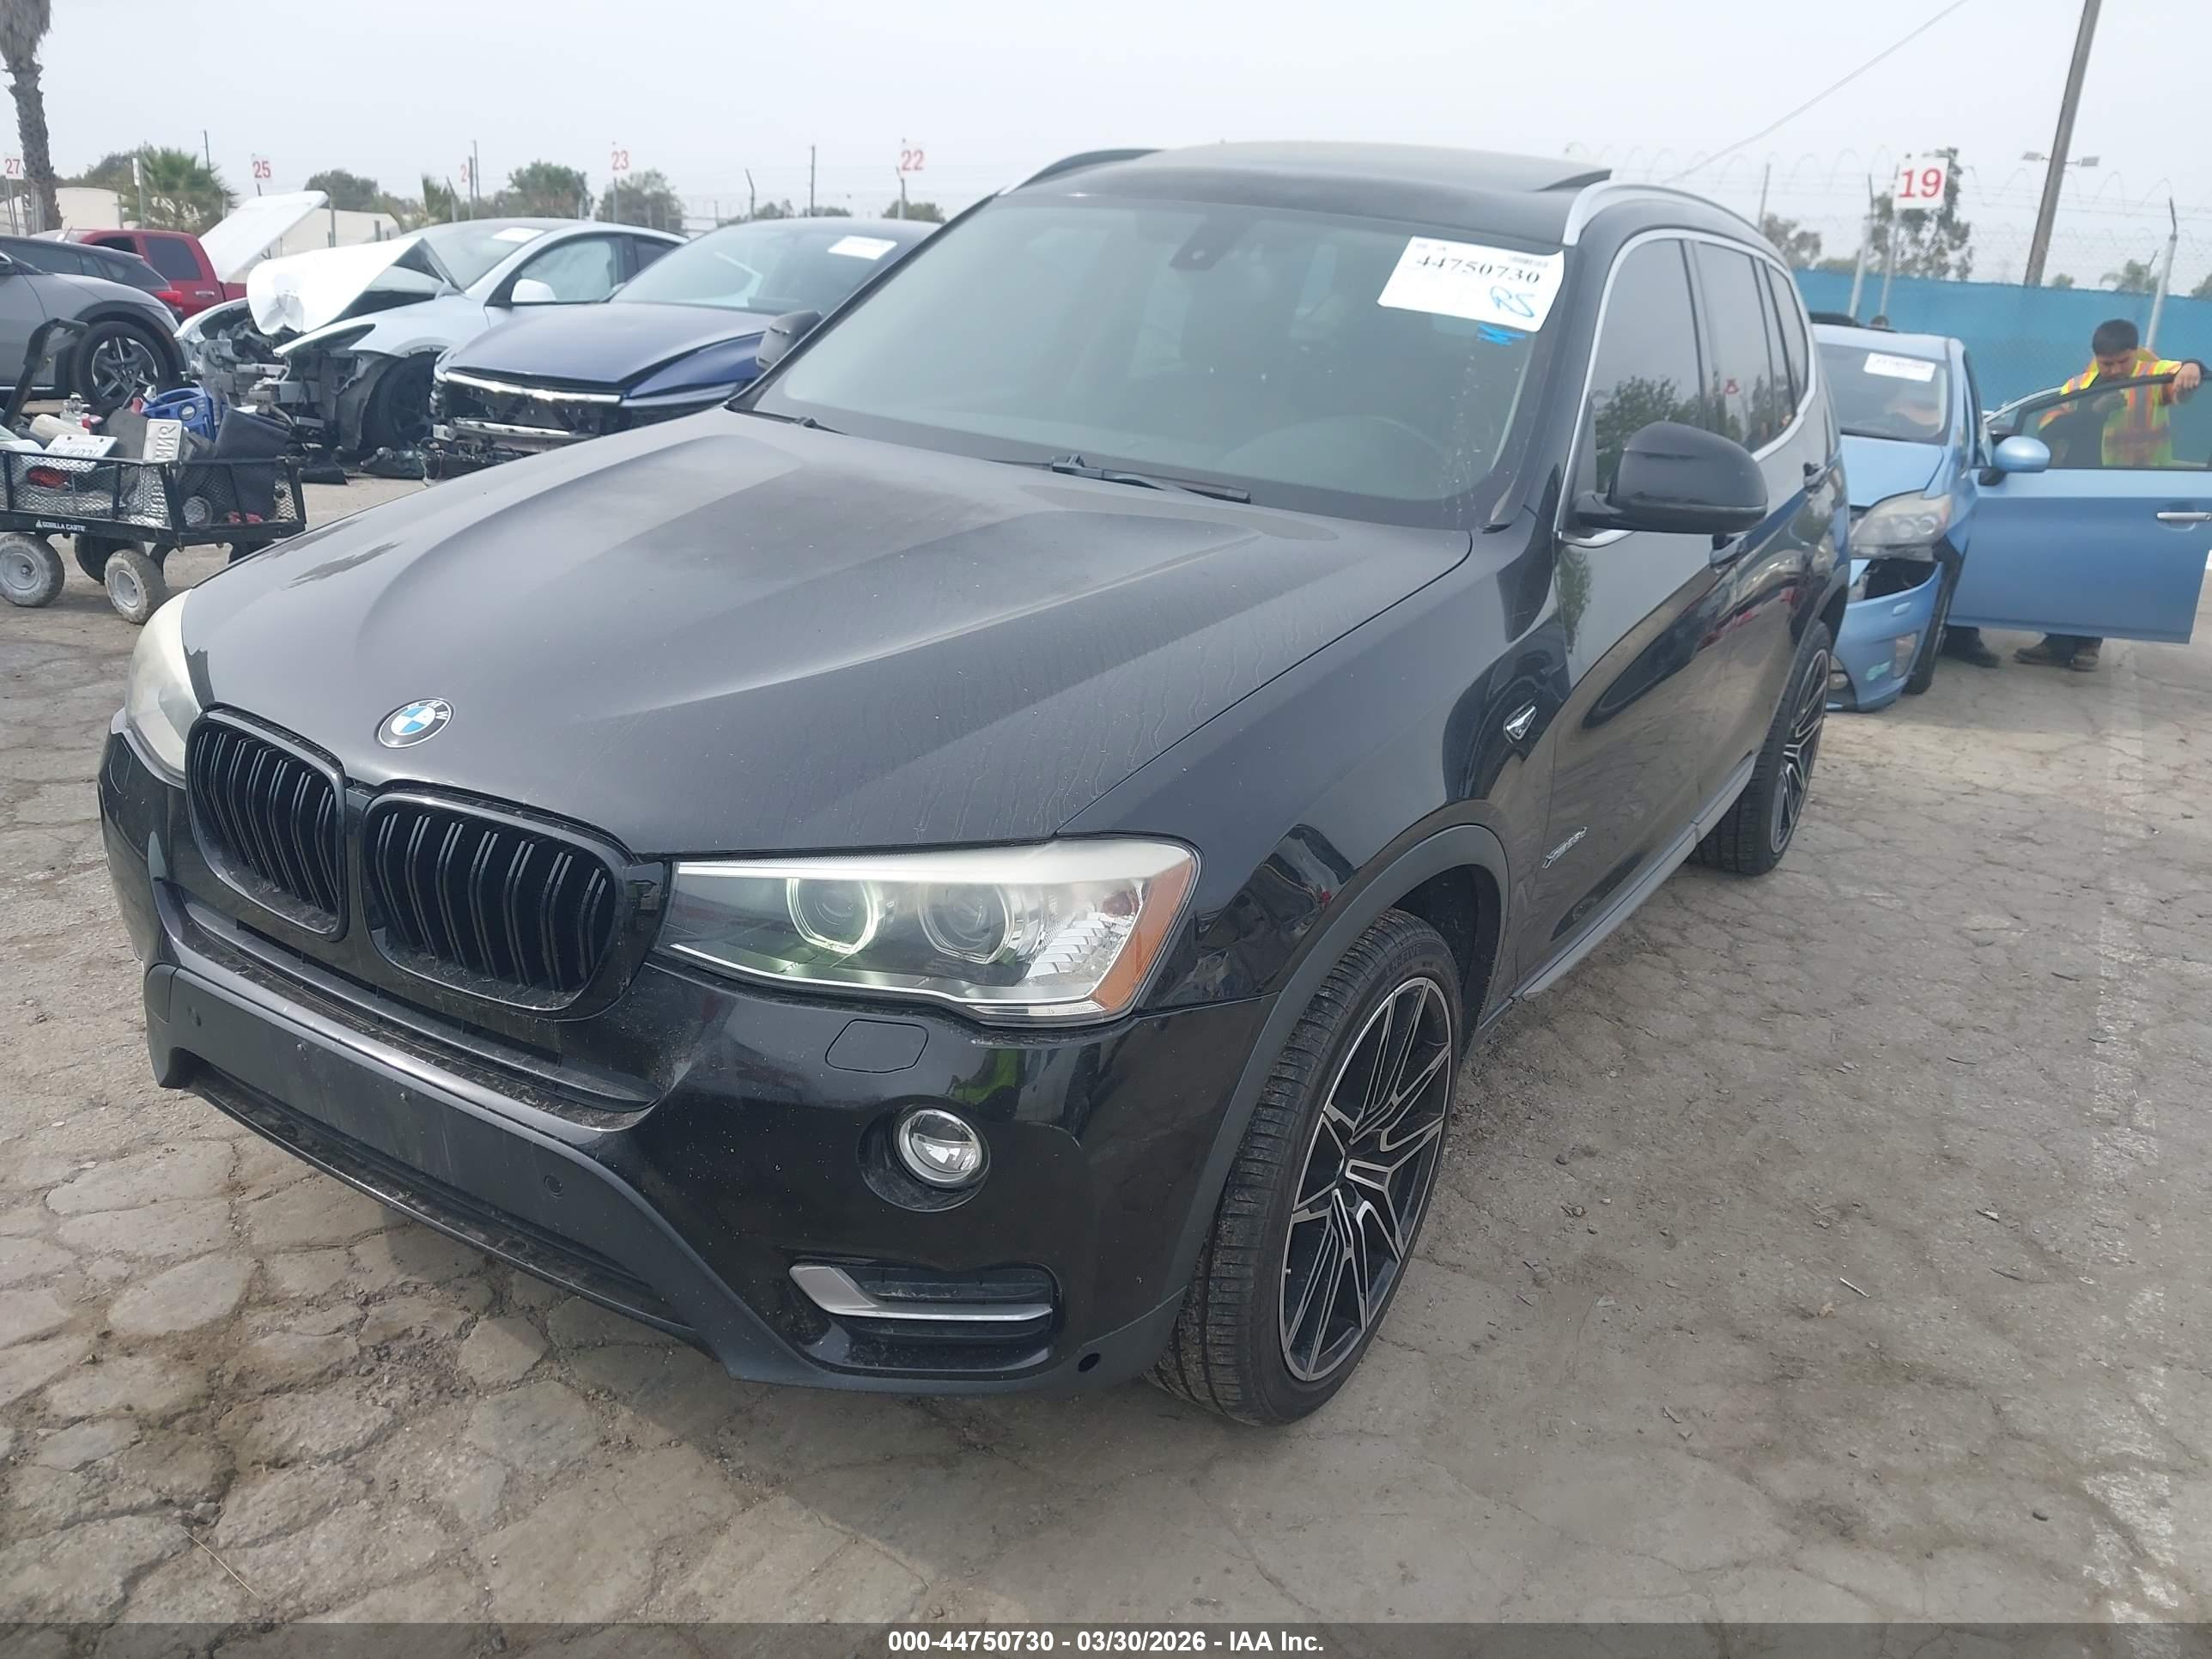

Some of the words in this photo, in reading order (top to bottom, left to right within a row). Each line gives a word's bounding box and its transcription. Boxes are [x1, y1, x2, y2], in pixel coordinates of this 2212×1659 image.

[5, 158, 21, 174] 27
[252, 161, 271, 179] 25
[611, 150, 629, 171] 23
[901, 149, 924, 171] 22
[1899, 168, 1941, 198] 19
[1416, 255, 1540, 284] 44750730
